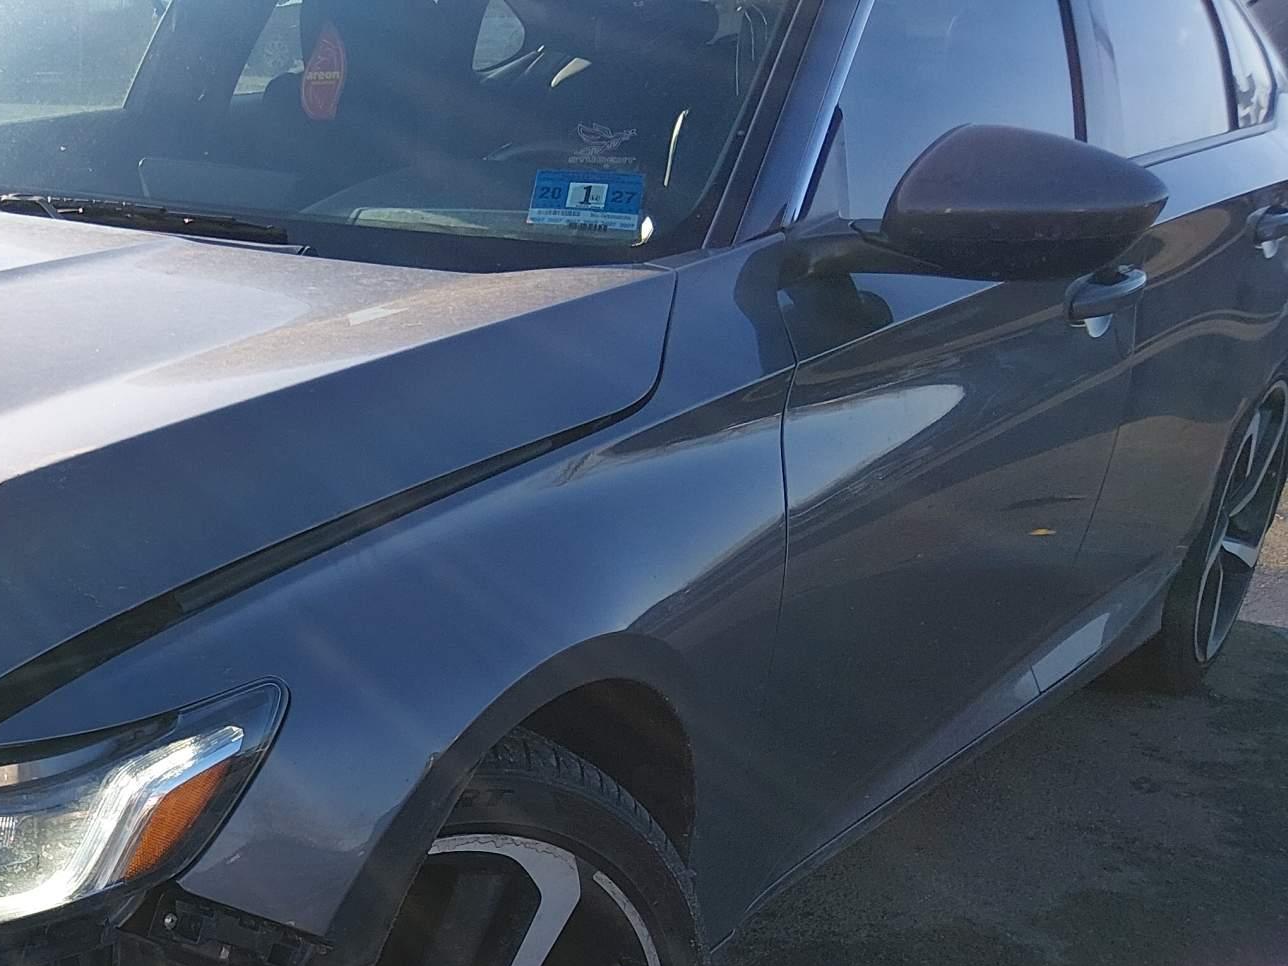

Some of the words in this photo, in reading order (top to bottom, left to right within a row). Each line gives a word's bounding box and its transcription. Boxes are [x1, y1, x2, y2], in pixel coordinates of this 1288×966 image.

[539, 186, 562, 200] 20
[579, 185, 593, 206] 1
[612, 190, 637, 204] 27
